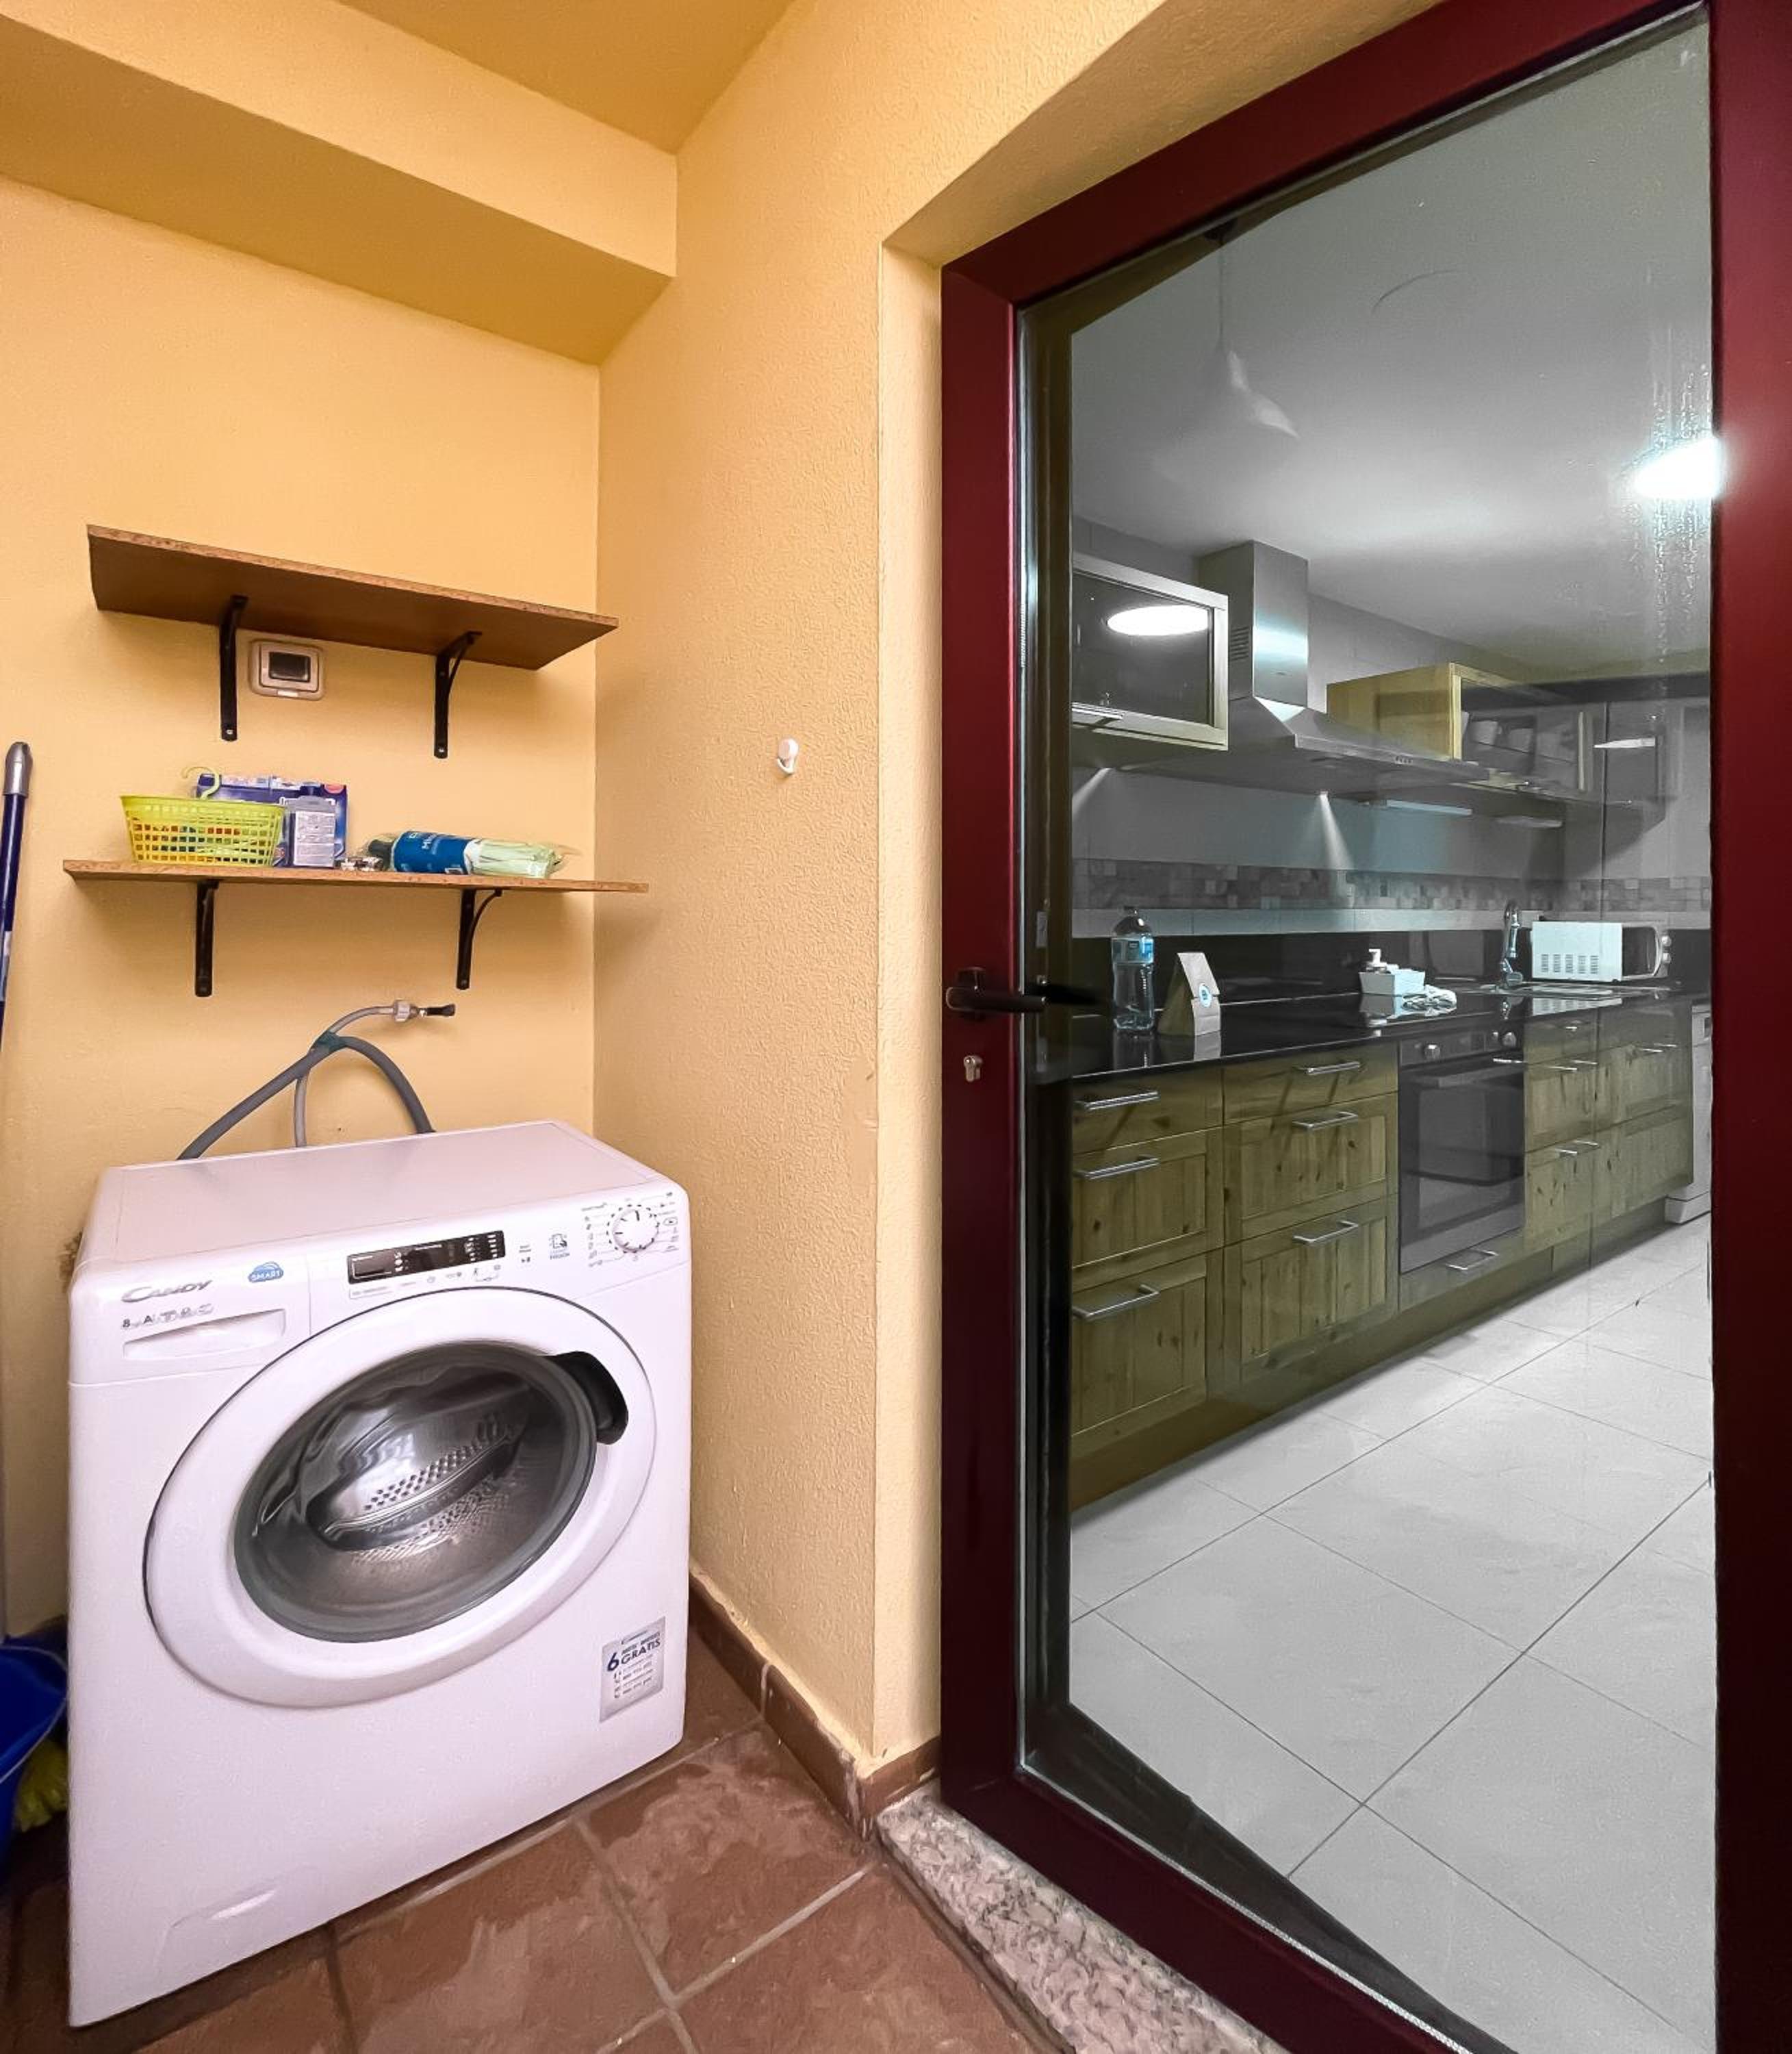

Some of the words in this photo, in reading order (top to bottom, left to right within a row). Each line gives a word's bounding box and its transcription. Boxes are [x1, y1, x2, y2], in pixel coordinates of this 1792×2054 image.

[123, 1319, 131, 1328] 8
[607, 1652, 619, 1671] 6
[621, 1638, 661, 1664] GRATIS
